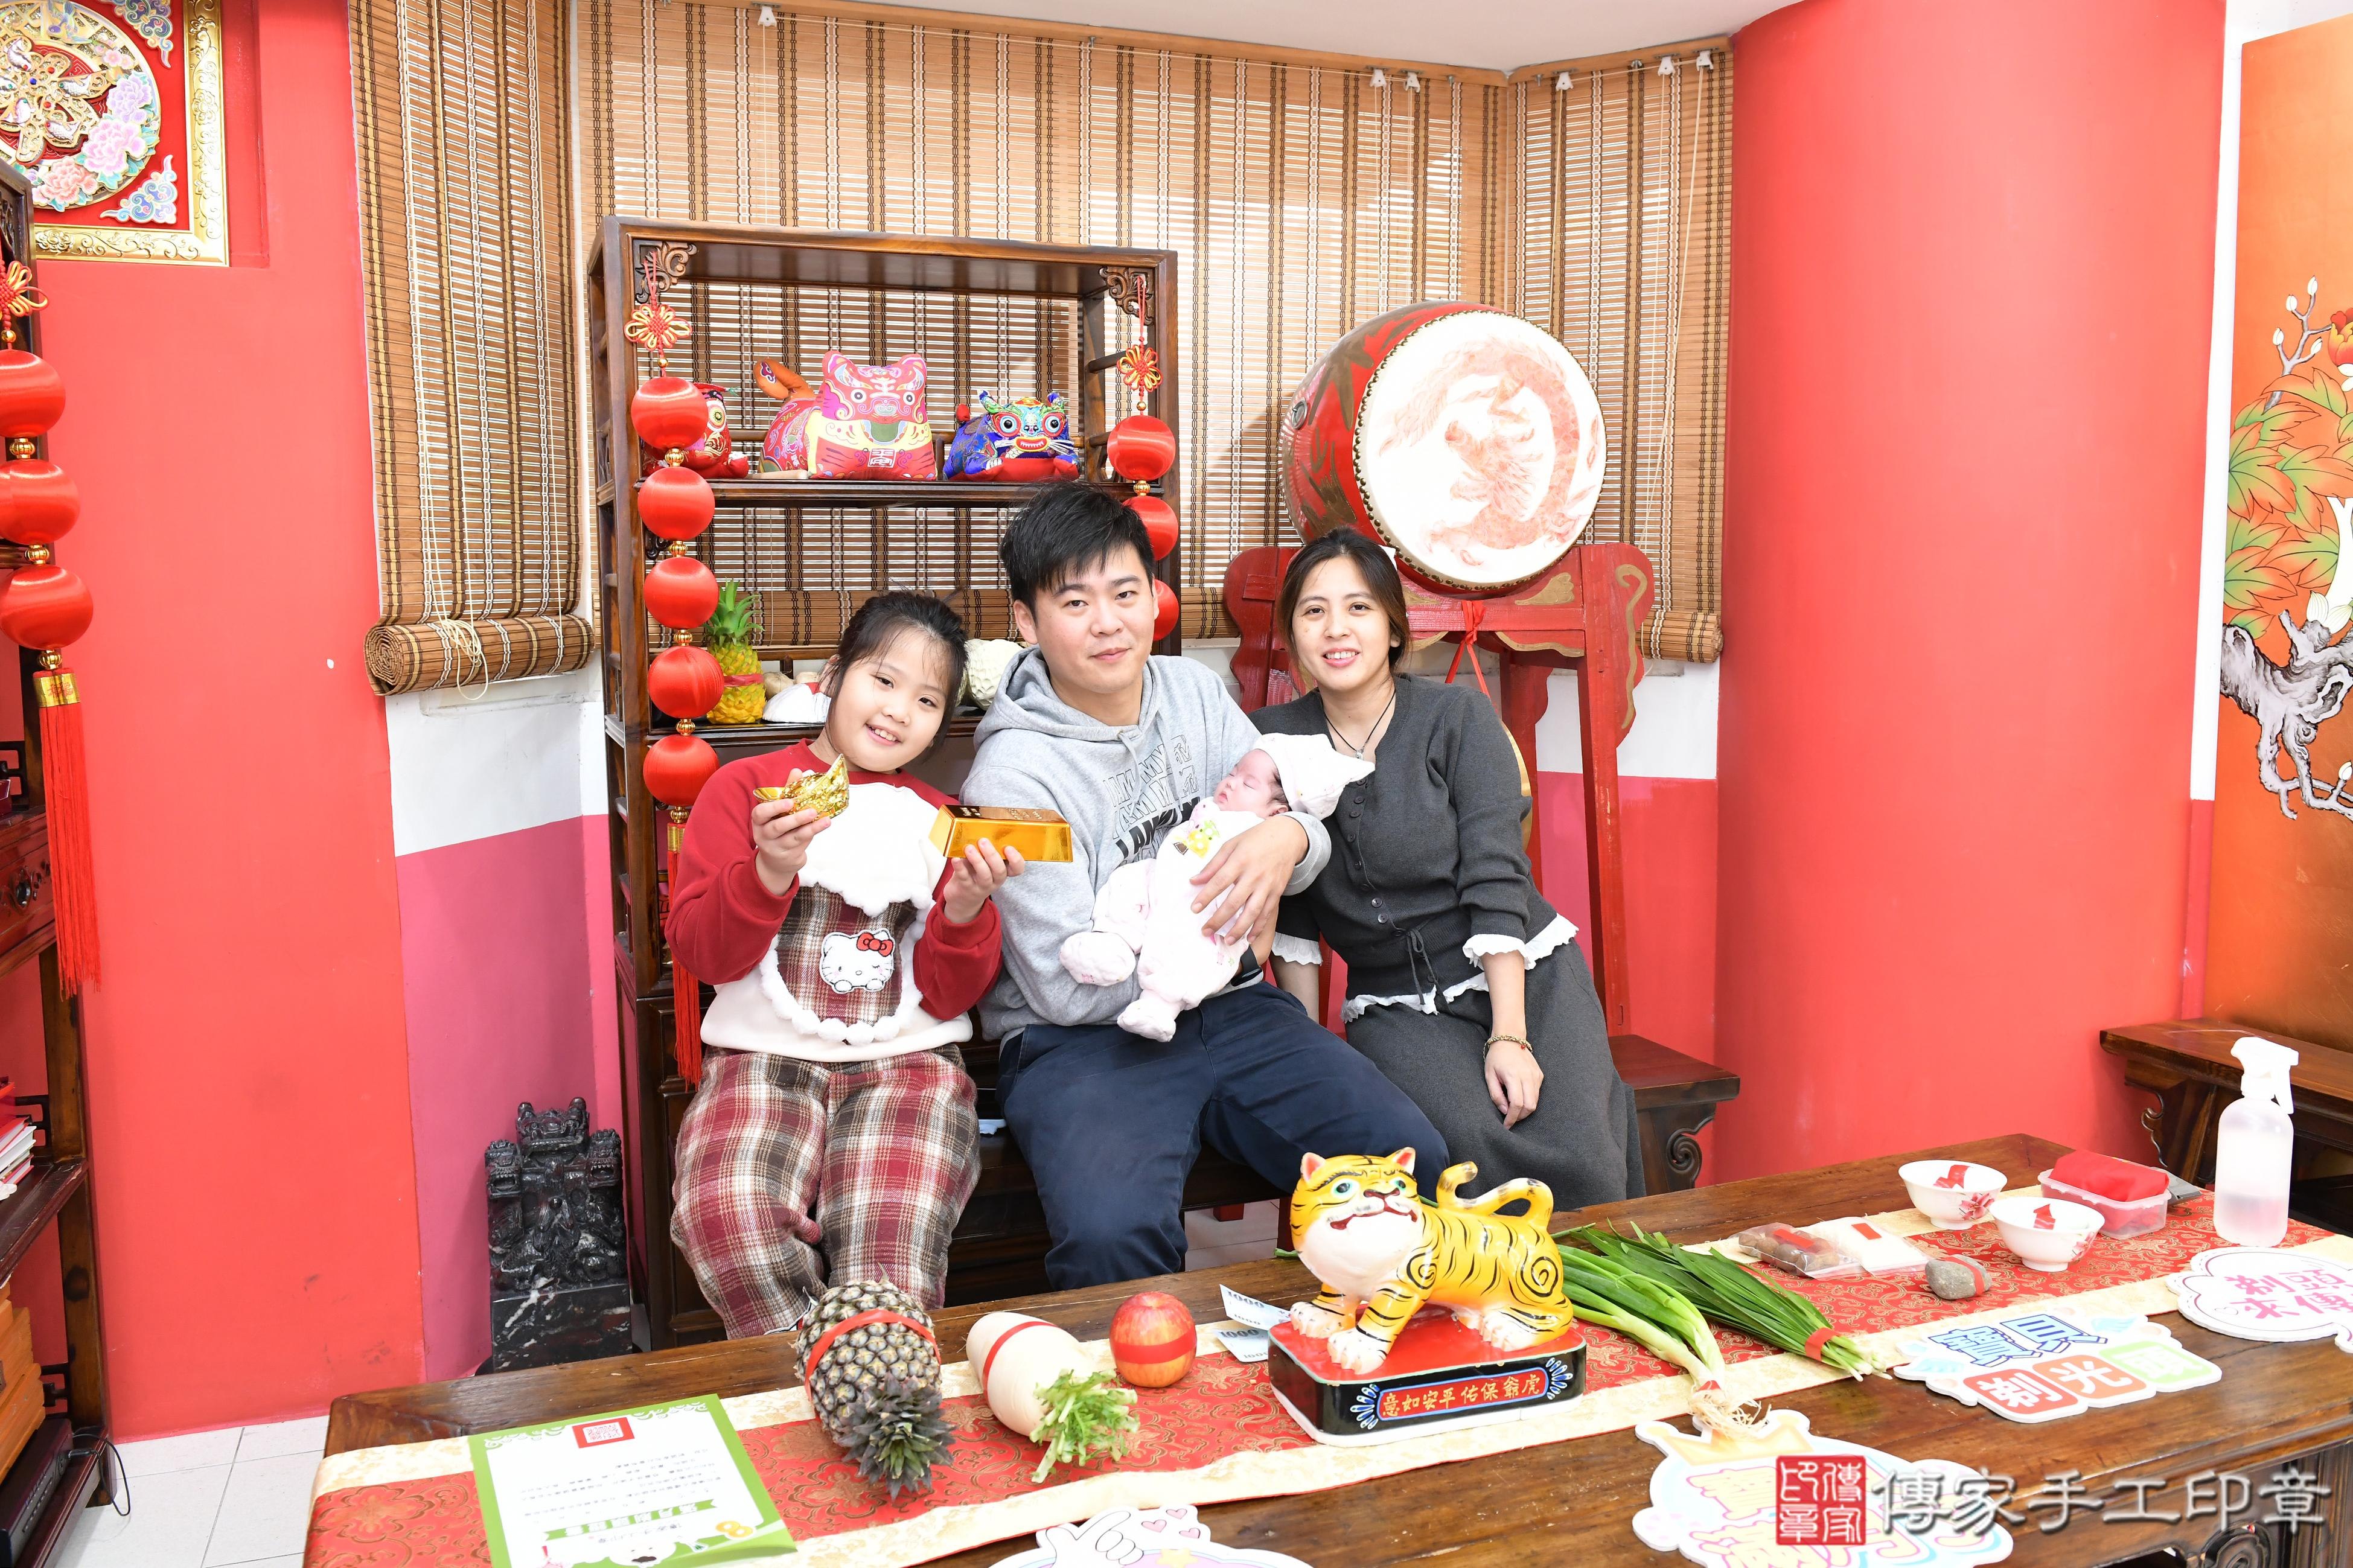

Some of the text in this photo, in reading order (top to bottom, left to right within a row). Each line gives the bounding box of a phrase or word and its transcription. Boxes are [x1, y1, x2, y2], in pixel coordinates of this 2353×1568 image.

[1119, 792, 1157, 832] AM
[1227, 1290, 1265, 1308] 1000
[1219, 1329, 1259, 1338] 1000
